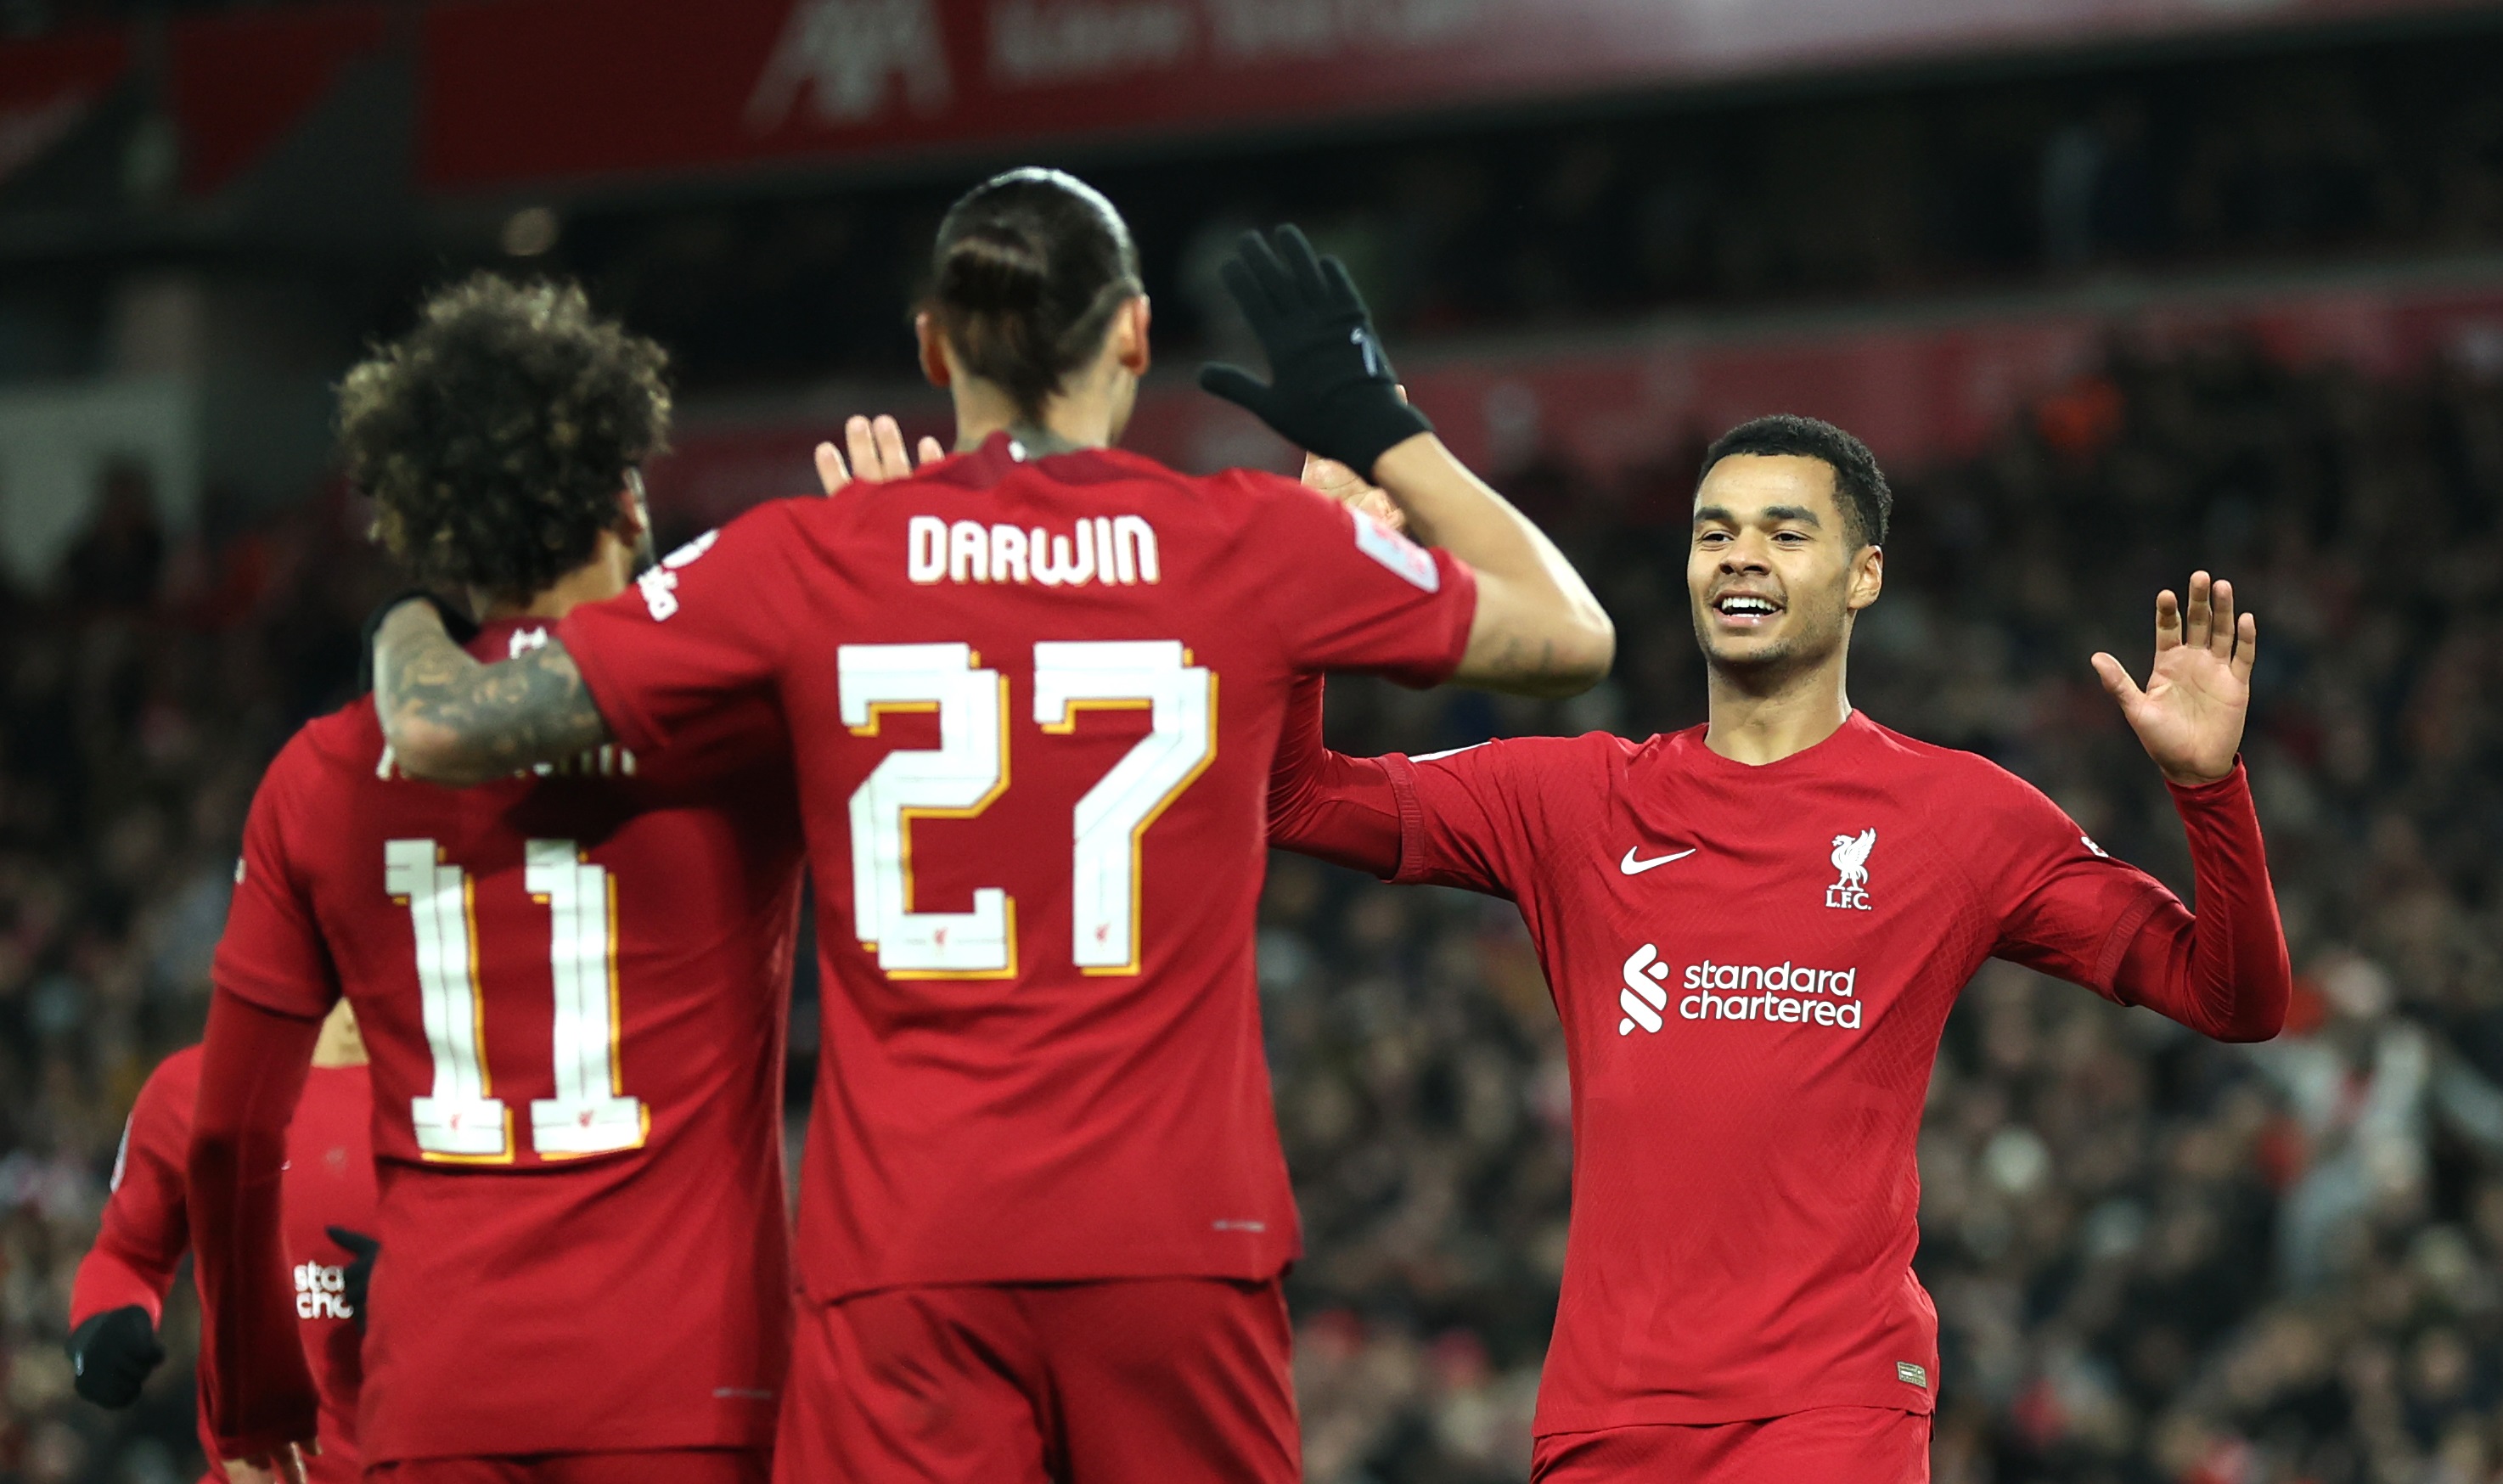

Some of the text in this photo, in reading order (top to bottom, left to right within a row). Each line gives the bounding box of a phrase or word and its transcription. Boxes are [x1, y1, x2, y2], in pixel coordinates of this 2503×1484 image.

[908, 514, 1160, 587] DARWIN
[837, 640, 1218, 980] 27
[1825, 891, 1873, 910] L.F.C.
[384, 838, 651, 1163] 11
[1683, 959, 1856, 998] standard
[1679, 990, 1862, 1029] chartered
